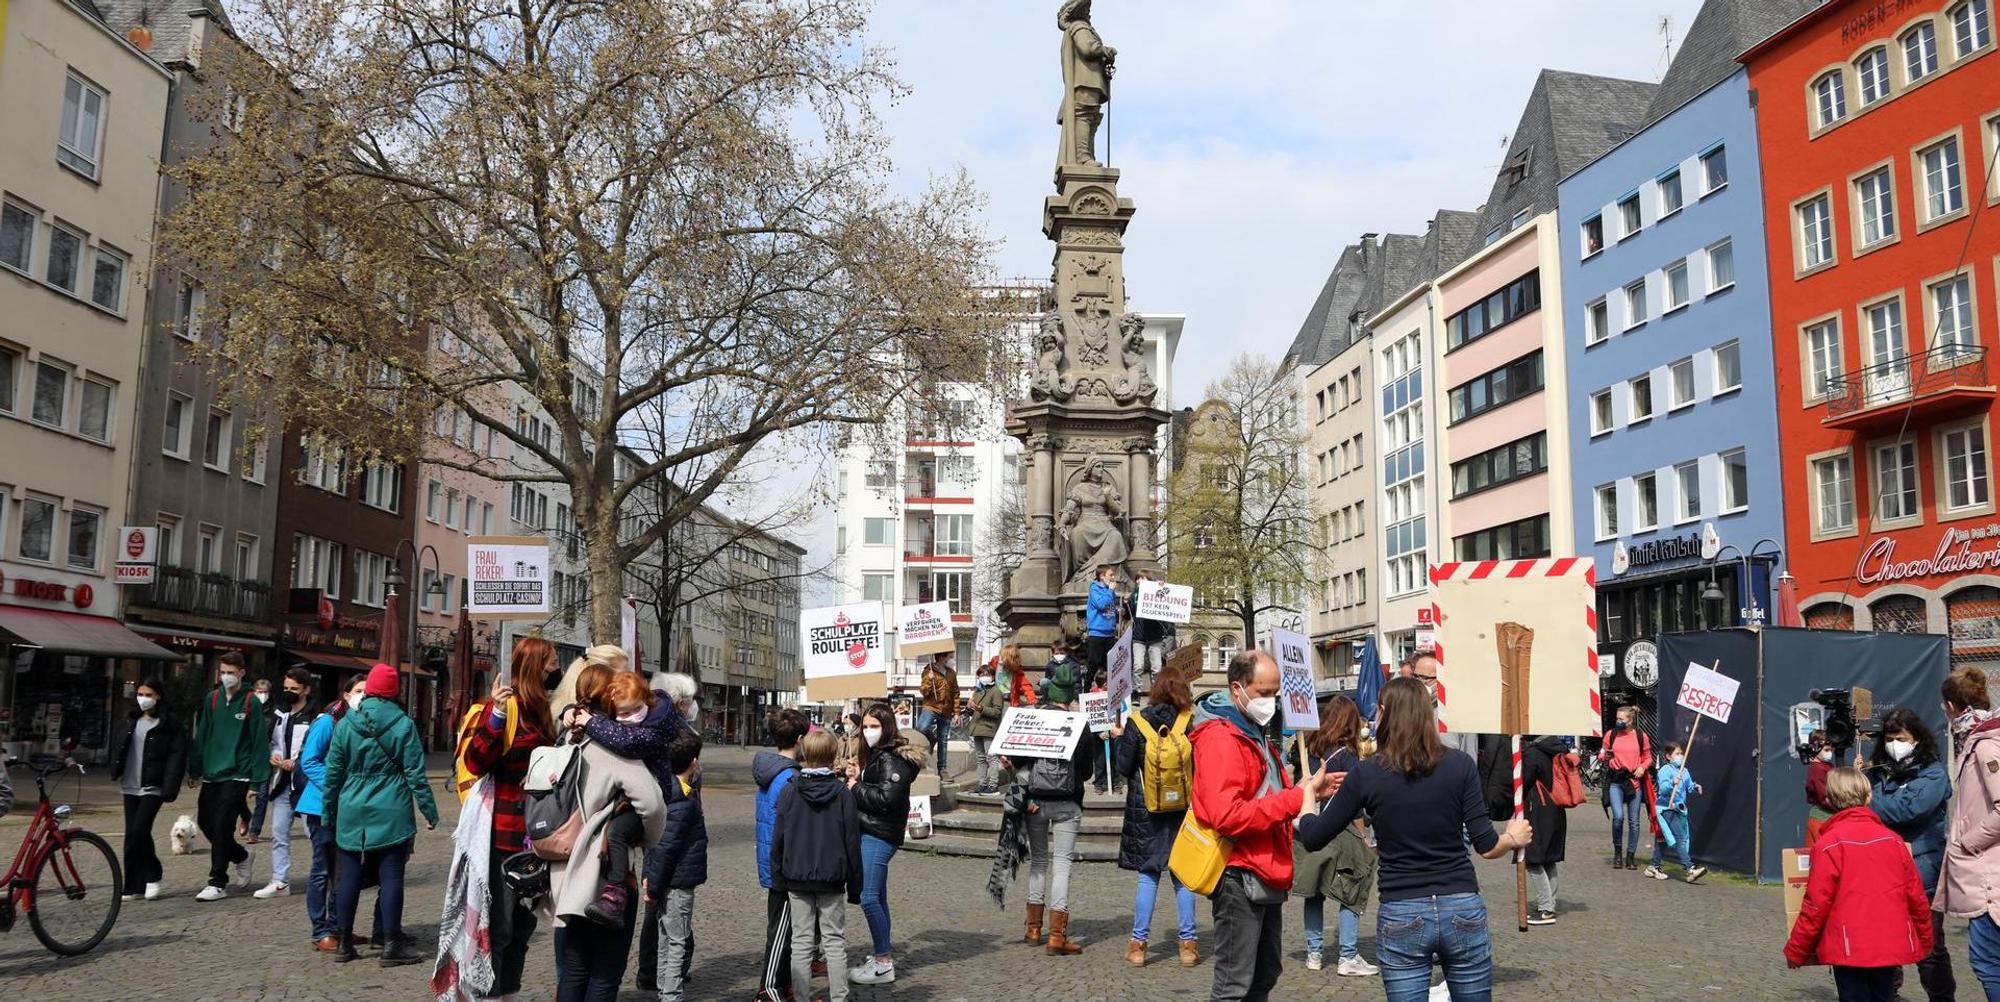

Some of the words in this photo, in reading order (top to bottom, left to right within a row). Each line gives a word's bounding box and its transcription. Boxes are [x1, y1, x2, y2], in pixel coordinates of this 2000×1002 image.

[475, 550, 497, 565] FRAU
[118, 567, 149, 577] KIOSK
[475, 565, 504, 580] REKER!
[15, 578, 67, 602] KIOSK
[531, 582, 542, 590] DAS
[475, 592, 542, 604] SCHULPLATZ-CASINO!
[1143, 592, 1188, 607] BILDUNG
[914, 609, 931, 620] LOS
[904, 624, 930, 633] MACHEN
[930, 622, 944, 630] NUR
[905, 617, 941, 628] VERFAHREN
[811, 622, 878, 641] SCHULPLATZ
[812, 636, 880, 655] ROULETTE!
[850, 649, 867, 661] STOP
[1282, 643, 1304, 664] ALLEIN
[1289, 691, 1312, 715] NEIN!
[1679, 682, 1733, 719] RESPEKT
[1015, 712, 1037, 720] Frau
[1012, 719, 1045, 727] Reker!
[1004, 735, 1025, 743] ist
[1025, 735, 1057, 745] kein
